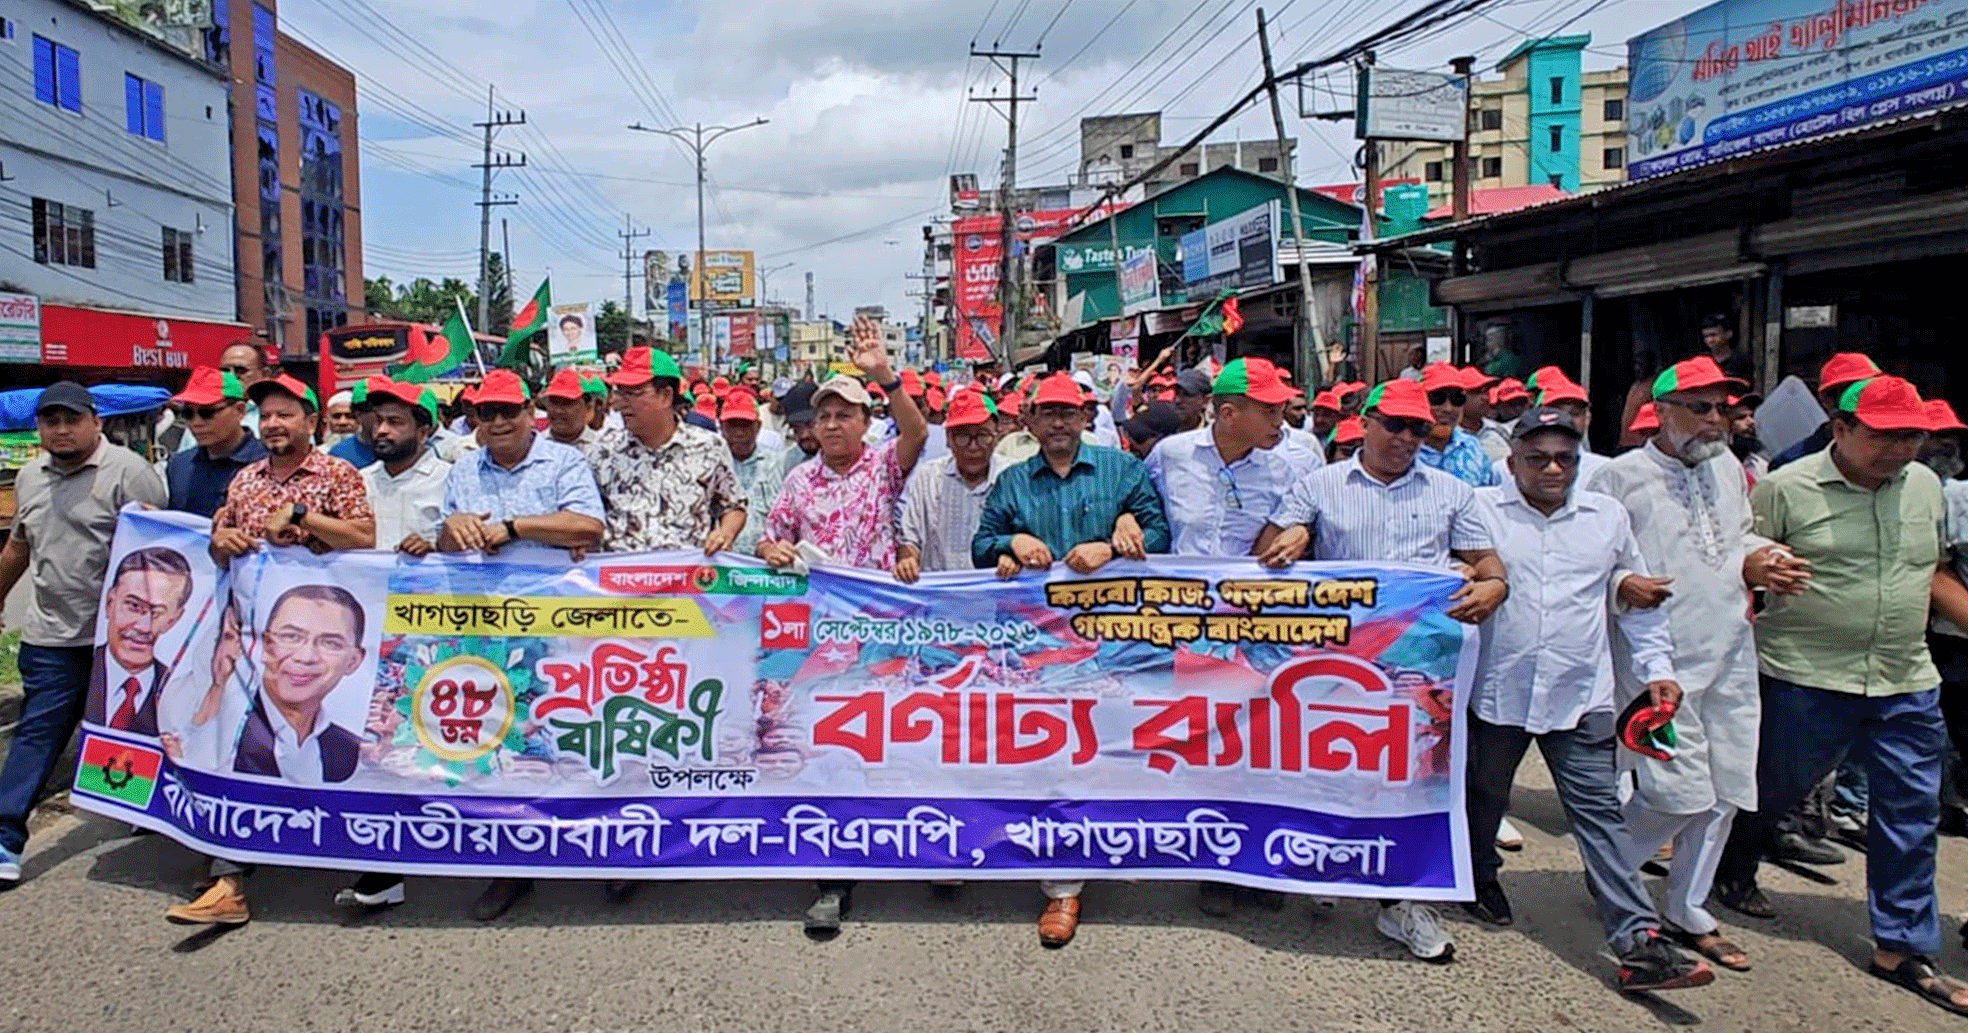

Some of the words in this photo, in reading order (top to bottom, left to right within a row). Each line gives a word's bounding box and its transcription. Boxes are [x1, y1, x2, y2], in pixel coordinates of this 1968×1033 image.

[609, 572, 687, 587] বাংলাদেশ
[728, 569, 797, 589] জিন্দাবাদ
[1048, 580, 1138, 607] করবো
[1217, 580, 1311, 611] গড়বো
[1314, 579, 1377, 606] দেশ
[393, 599, 540, 633] খাগড়াছড়ি
[764, 610, 806, 640] ১লা
[815, 615, 899, 641] সেপ্টেম্বর
[902, 620, 1037, 645] ১৯৭৮-২০২৬
[1073, 607, 1202, 646] গণতান্ত্রিক
[1205, 615, 1349, 644] বাংলাদেশ
[429, 678, 498, 718] ৪৮
[535, 644, 689, 719] প্রতিষ্ঠা
[549, 678, 724, 780] বার্ষিকী
[813, 656, 1097, 765] বর্ণাঢ্য
[439, 719, 482, 745] তম
[649, 765, 756, 790] উপলক্ষে
[340, 801, 671, 858] জাতীয়তাবাদী
[1006, 806, 1249, 866] খাগড়াছড়ি
[1264, 825, 1395, 876] জেলা
